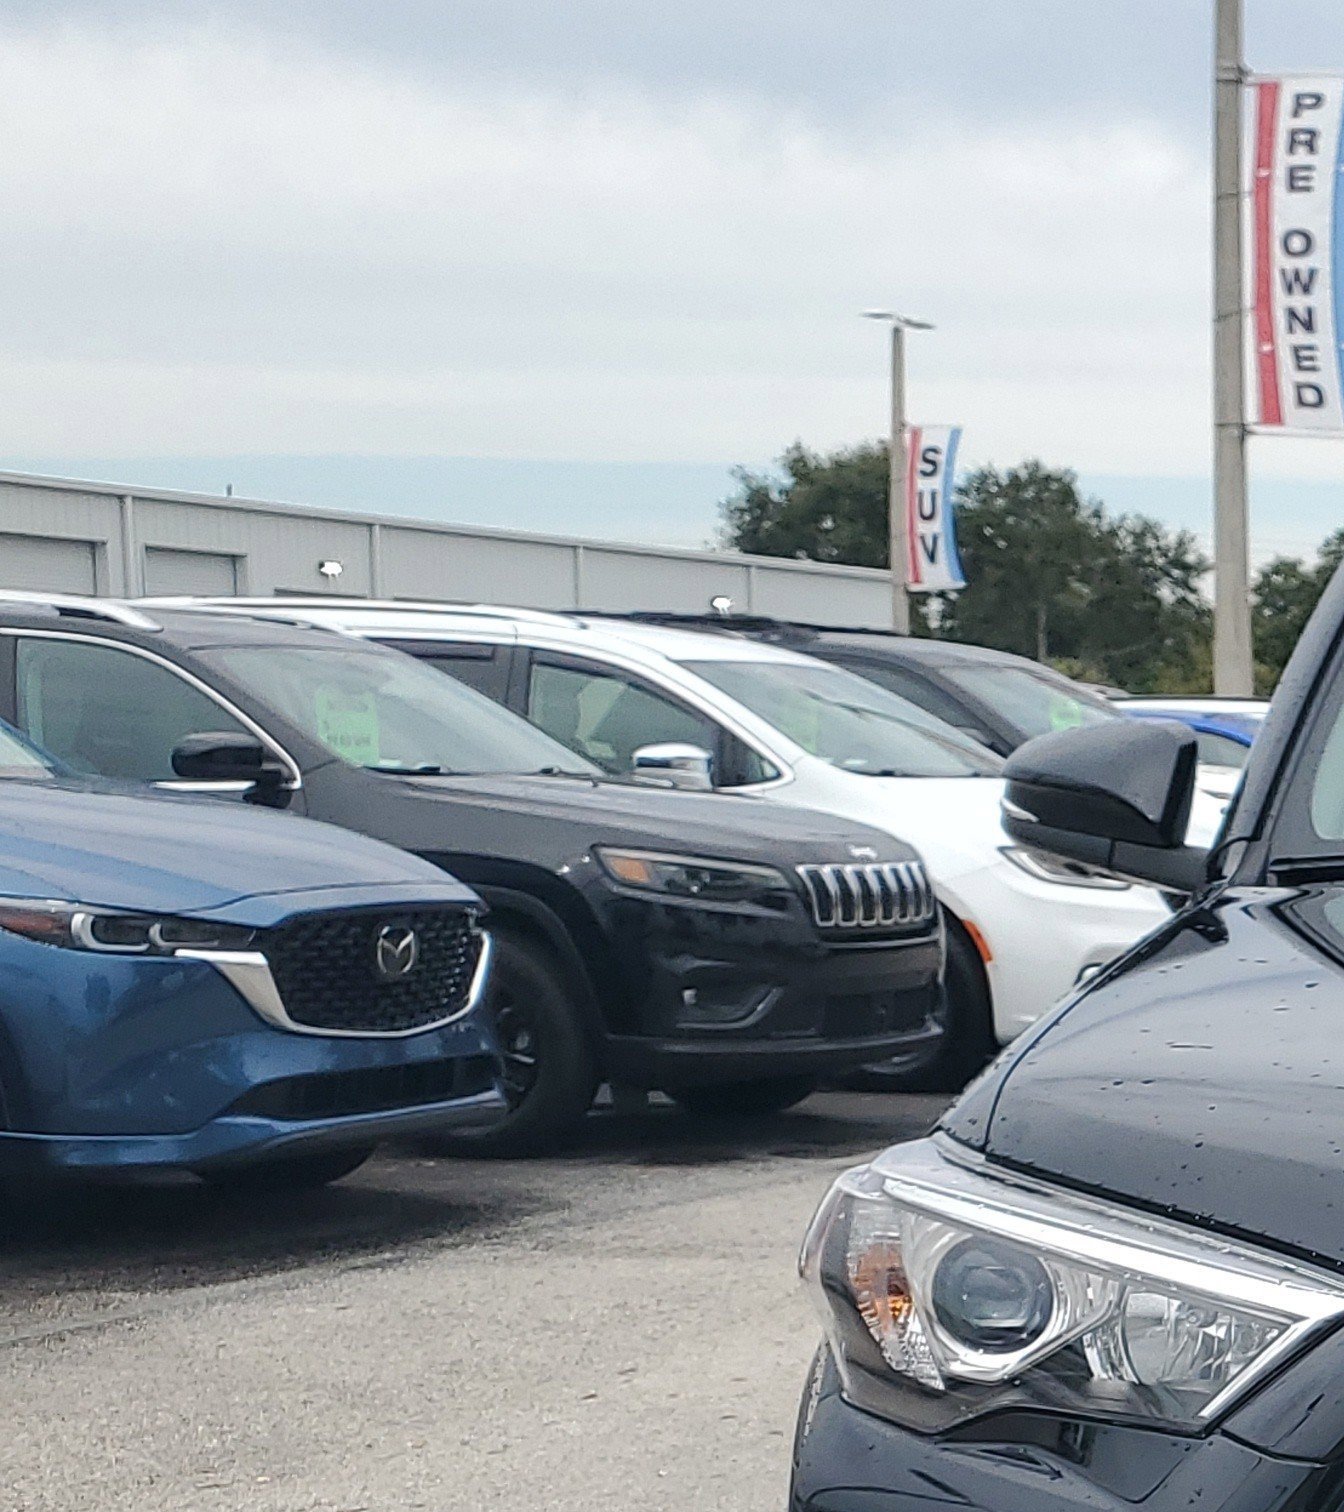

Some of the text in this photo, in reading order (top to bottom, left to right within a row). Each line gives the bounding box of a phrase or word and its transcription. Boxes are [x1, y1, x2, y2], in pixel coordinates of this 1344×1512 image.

[1280, 91, 1325, 409] PRE OWNED
[918, 446, 941, 564] SUV
